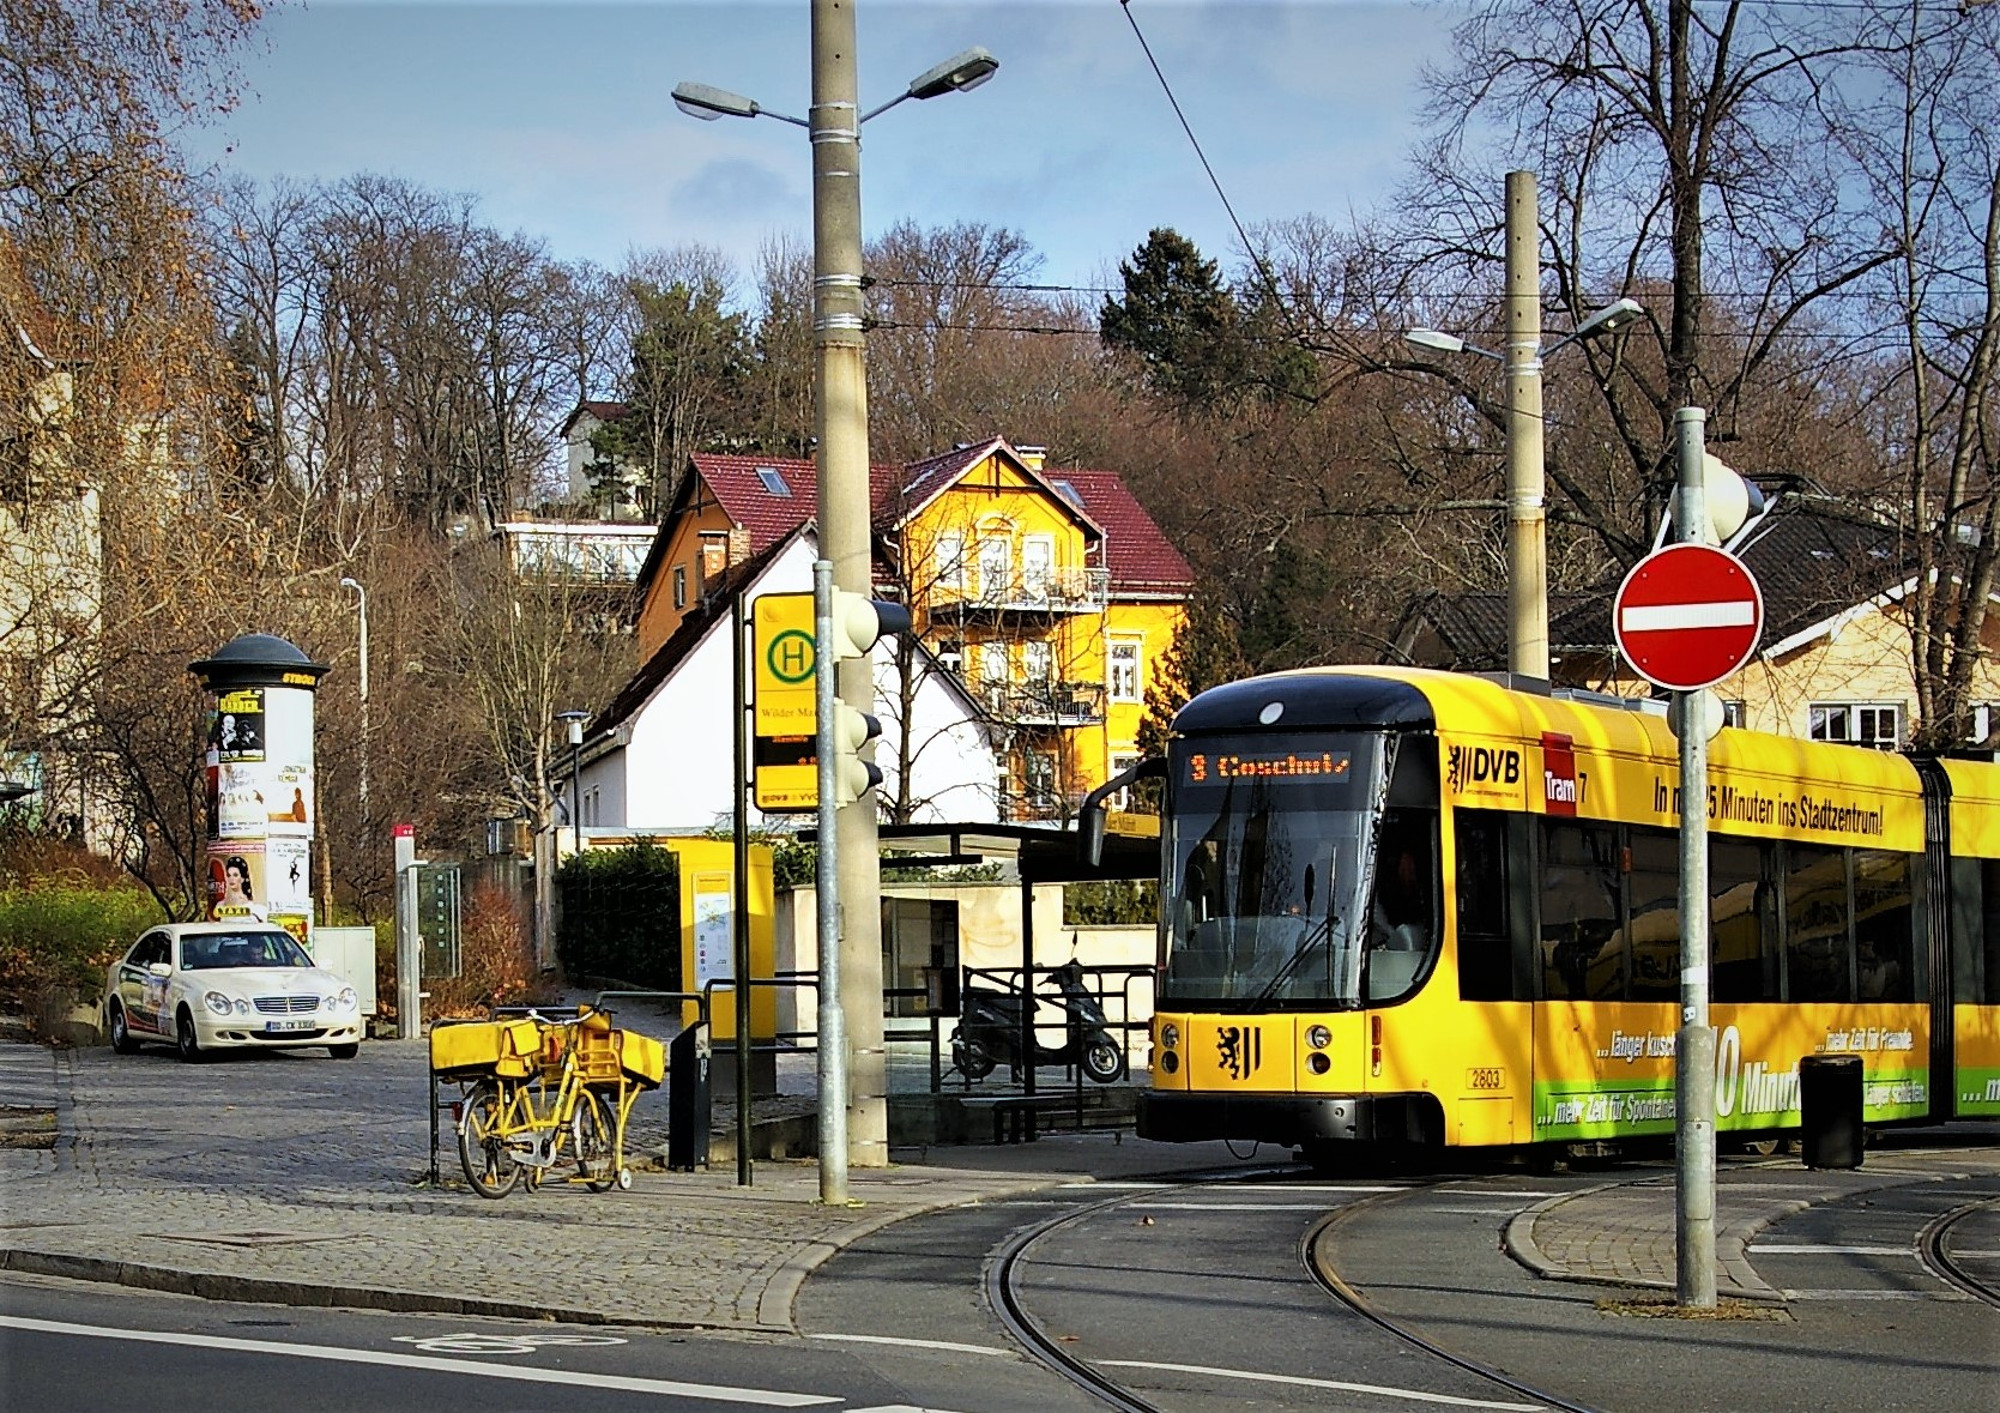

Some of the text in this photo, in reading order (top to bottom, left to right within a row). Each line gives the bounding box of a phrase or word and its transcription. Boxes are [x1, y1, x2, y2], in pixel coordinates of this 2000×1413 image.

[783, 641, 804, 672] H
[761, 707, 794, 718] Wilder
[1474, 747, 1520, 784] DVB
[1545, 770, 1587, 803] Tram 7
[1654, 776, 1668, 813] In
[1705, 784, 1717, 820] 5
[1721, 785, 1774, 823] Minuten
[1778, 792, 1797, 827] ins
[1800, 795, 1884, 837] Stadtzentrum!
[1609, 1093, 1624, 1121] für
